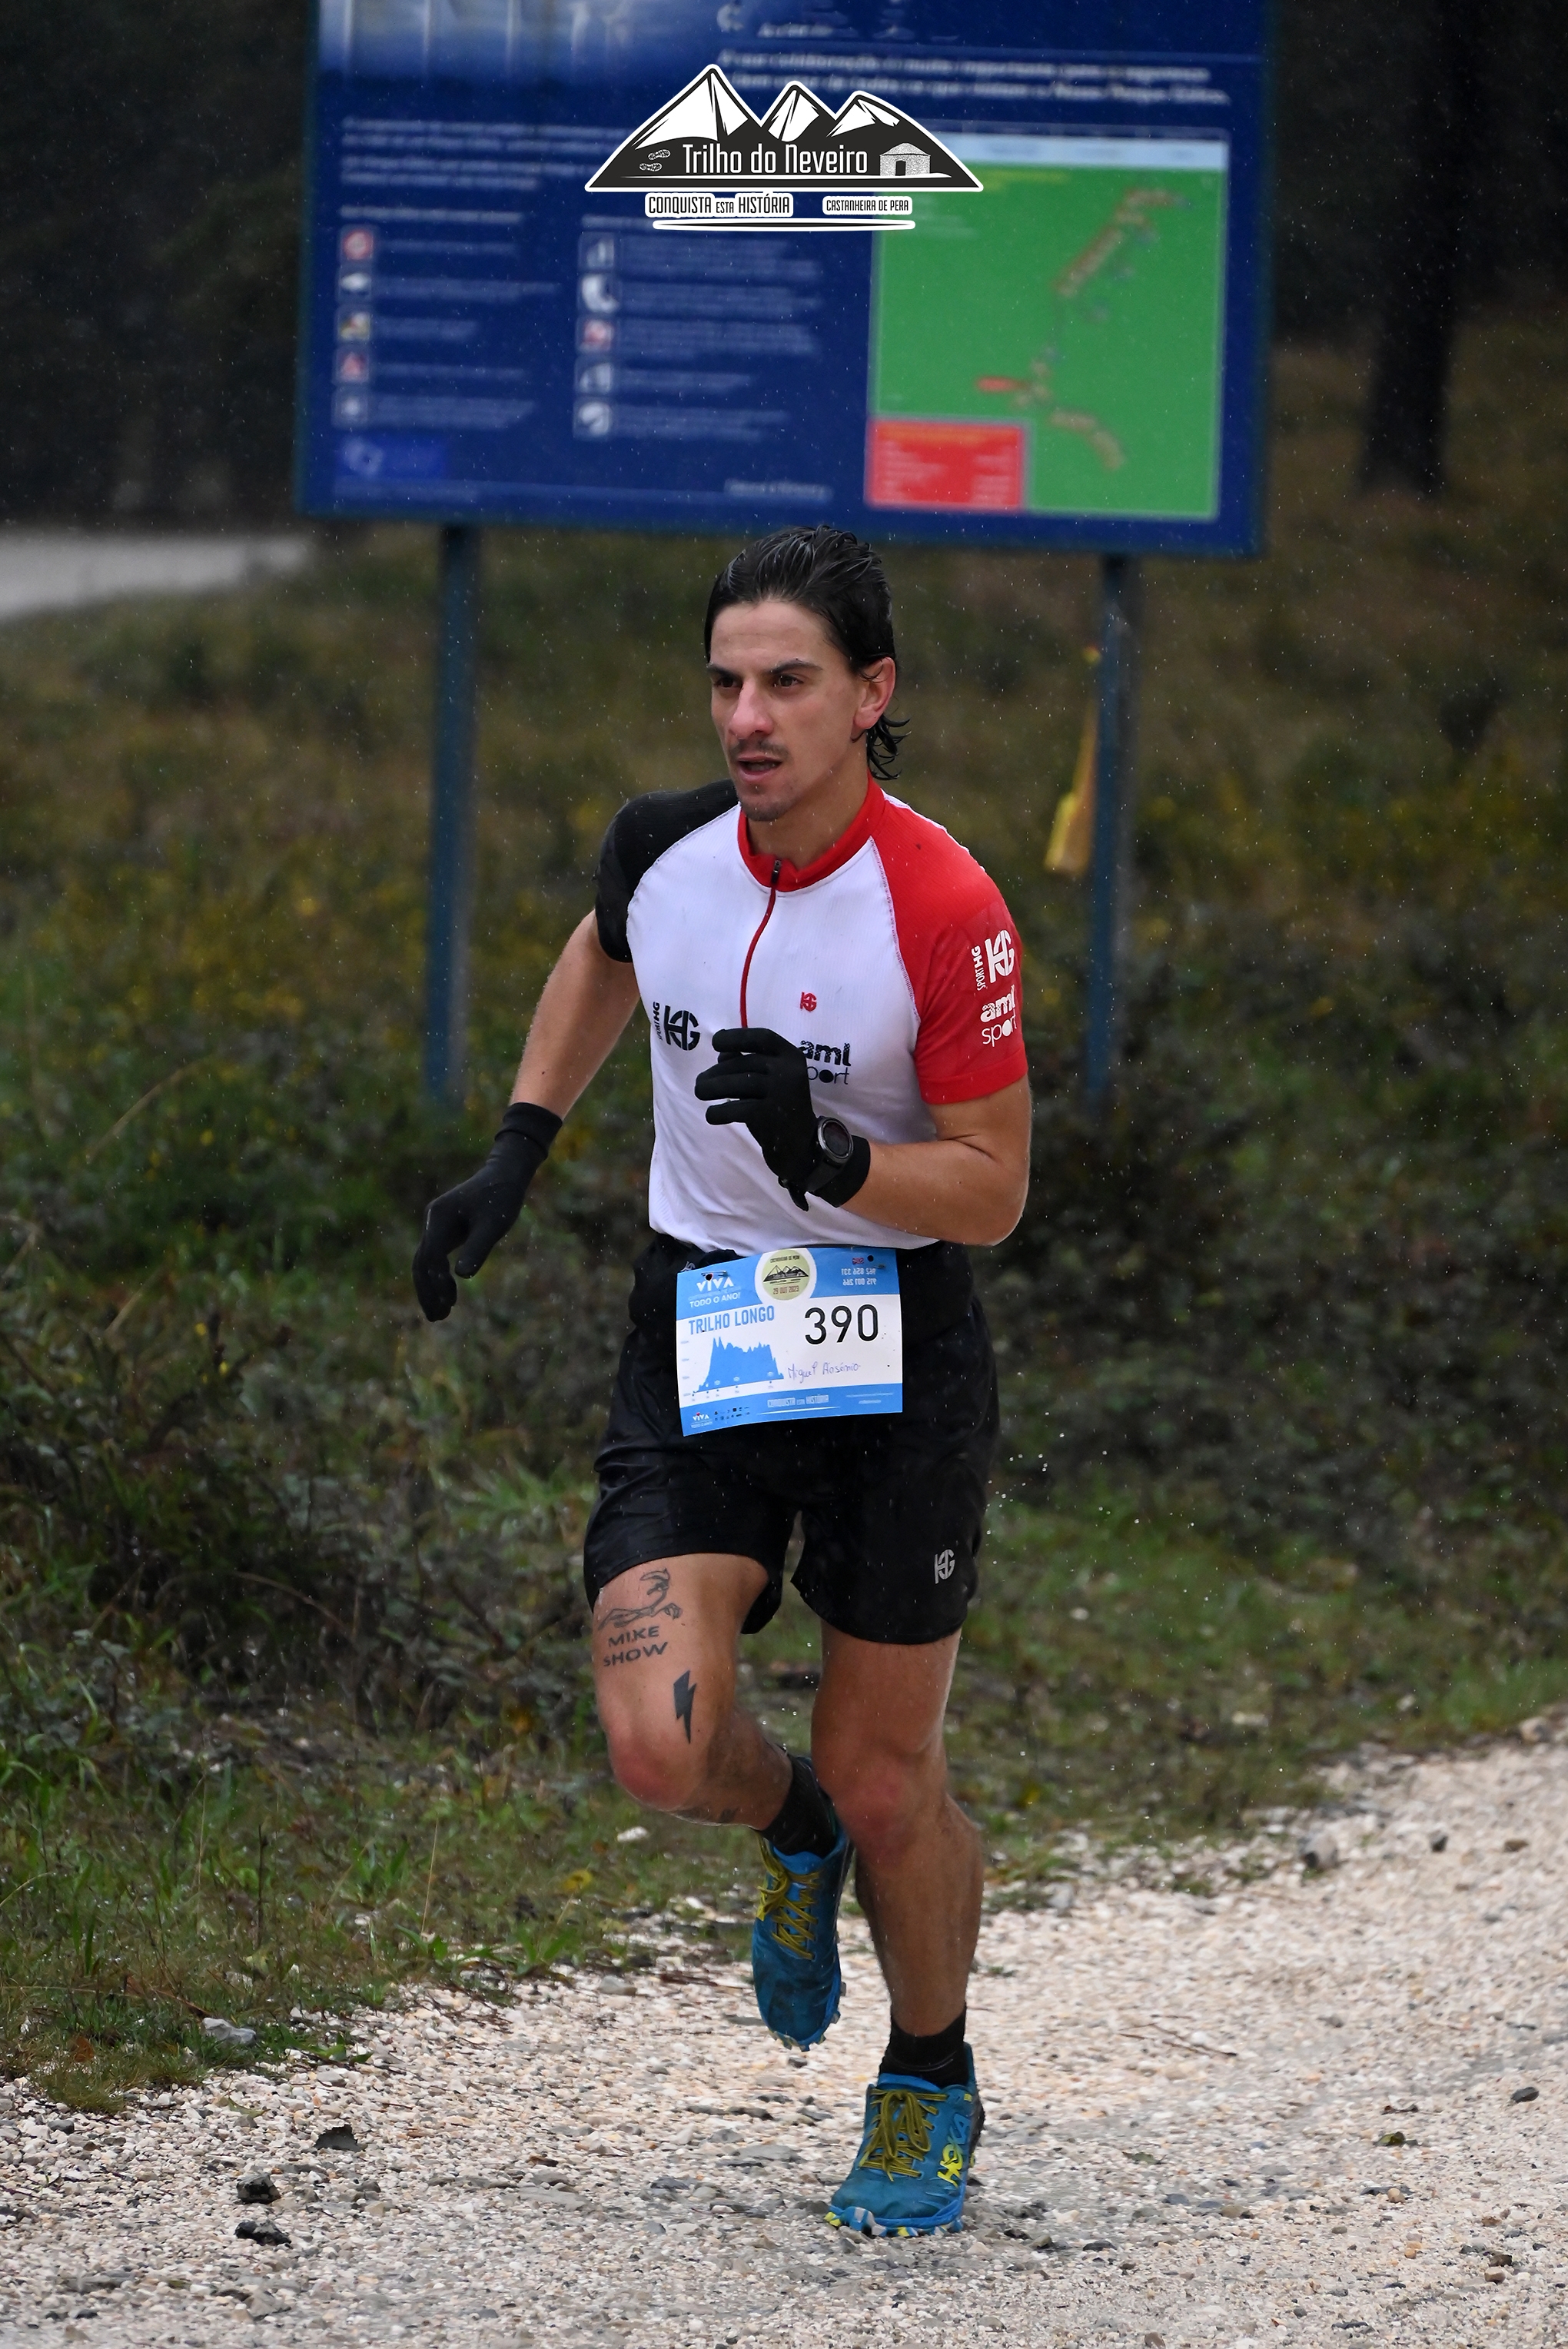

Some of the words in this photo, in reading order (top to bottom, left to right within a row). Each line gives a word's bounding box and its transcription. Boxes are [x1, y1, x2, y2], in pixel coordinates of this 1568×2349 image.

[982, 1008, 1017, 1048] sport
[689, 1297, 712, 1307] TODO
[689, 1313, 730, 1335] TRILHO
[735, 1305, 775, 1326] LONGO
[805, 1304, 879, 1345] 390
[608, 1626, 659, 1647] MIKE
[603, 1642, 668, 1666] SHOW
